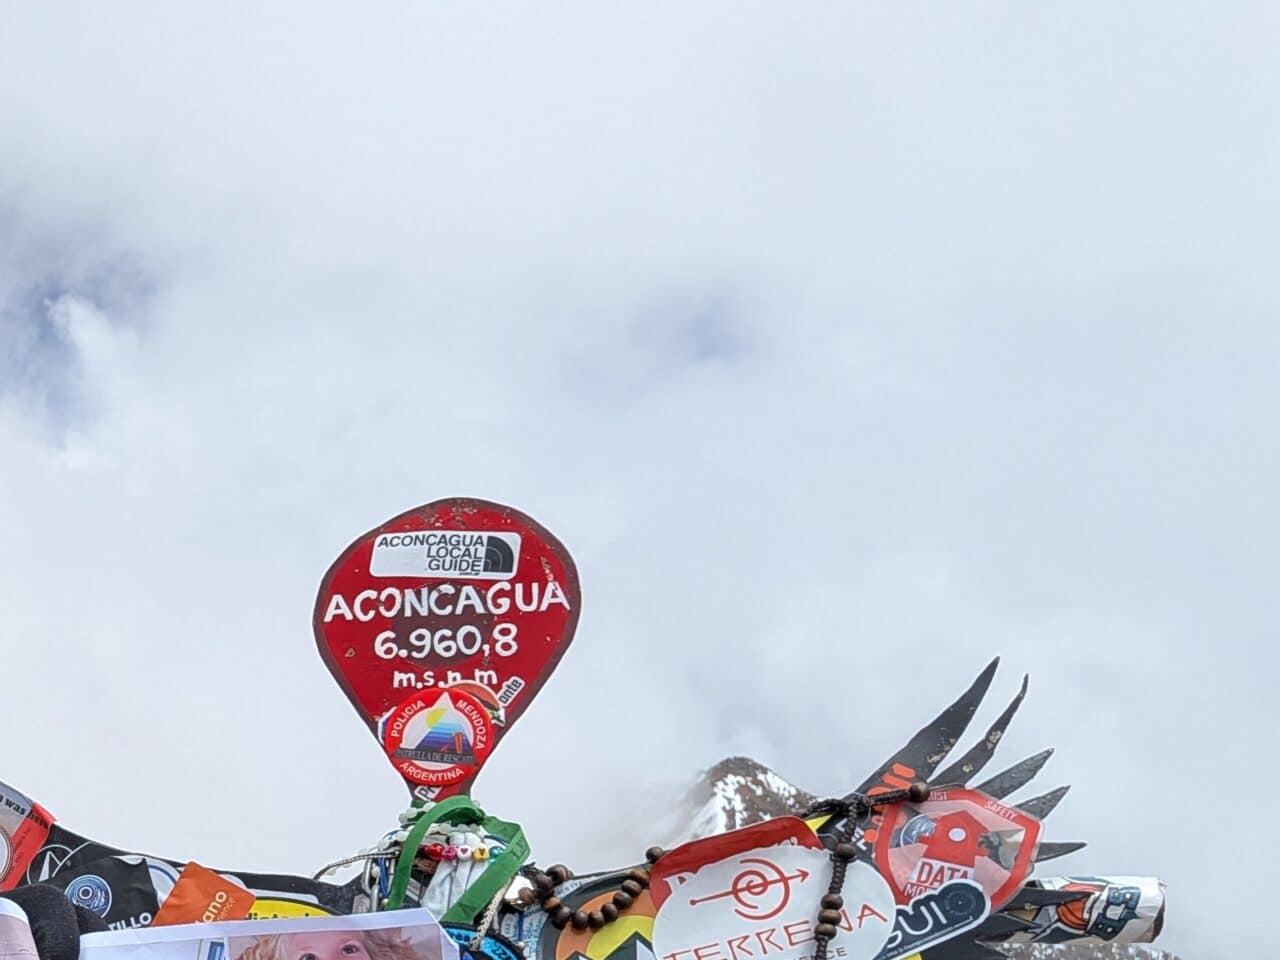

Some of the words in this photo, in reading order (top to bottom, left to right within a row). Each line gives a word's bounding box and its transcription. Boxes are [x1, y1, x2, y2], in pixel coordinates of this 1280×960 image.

[377, 533, 486, 548] ACONCAGUA
[426, 546, 483, 560] LOCAL
[427, 558, 482, 573] GUIDE
[323, 581, 571, 623] ACONCAGUA
[374, 622, 518, 660] 6.960,8
[391, 700, 425, 737] POLICIA
[456, 699, 487, 750] MENDOZA
[399, 762, 465, 783] ARGENTINA
[5, 797, 27, 816] was
[984, 800, 1018, 820] SAFETY
[916, 861, 968, 886] DATA
[195, 891, 227, 924] ano
